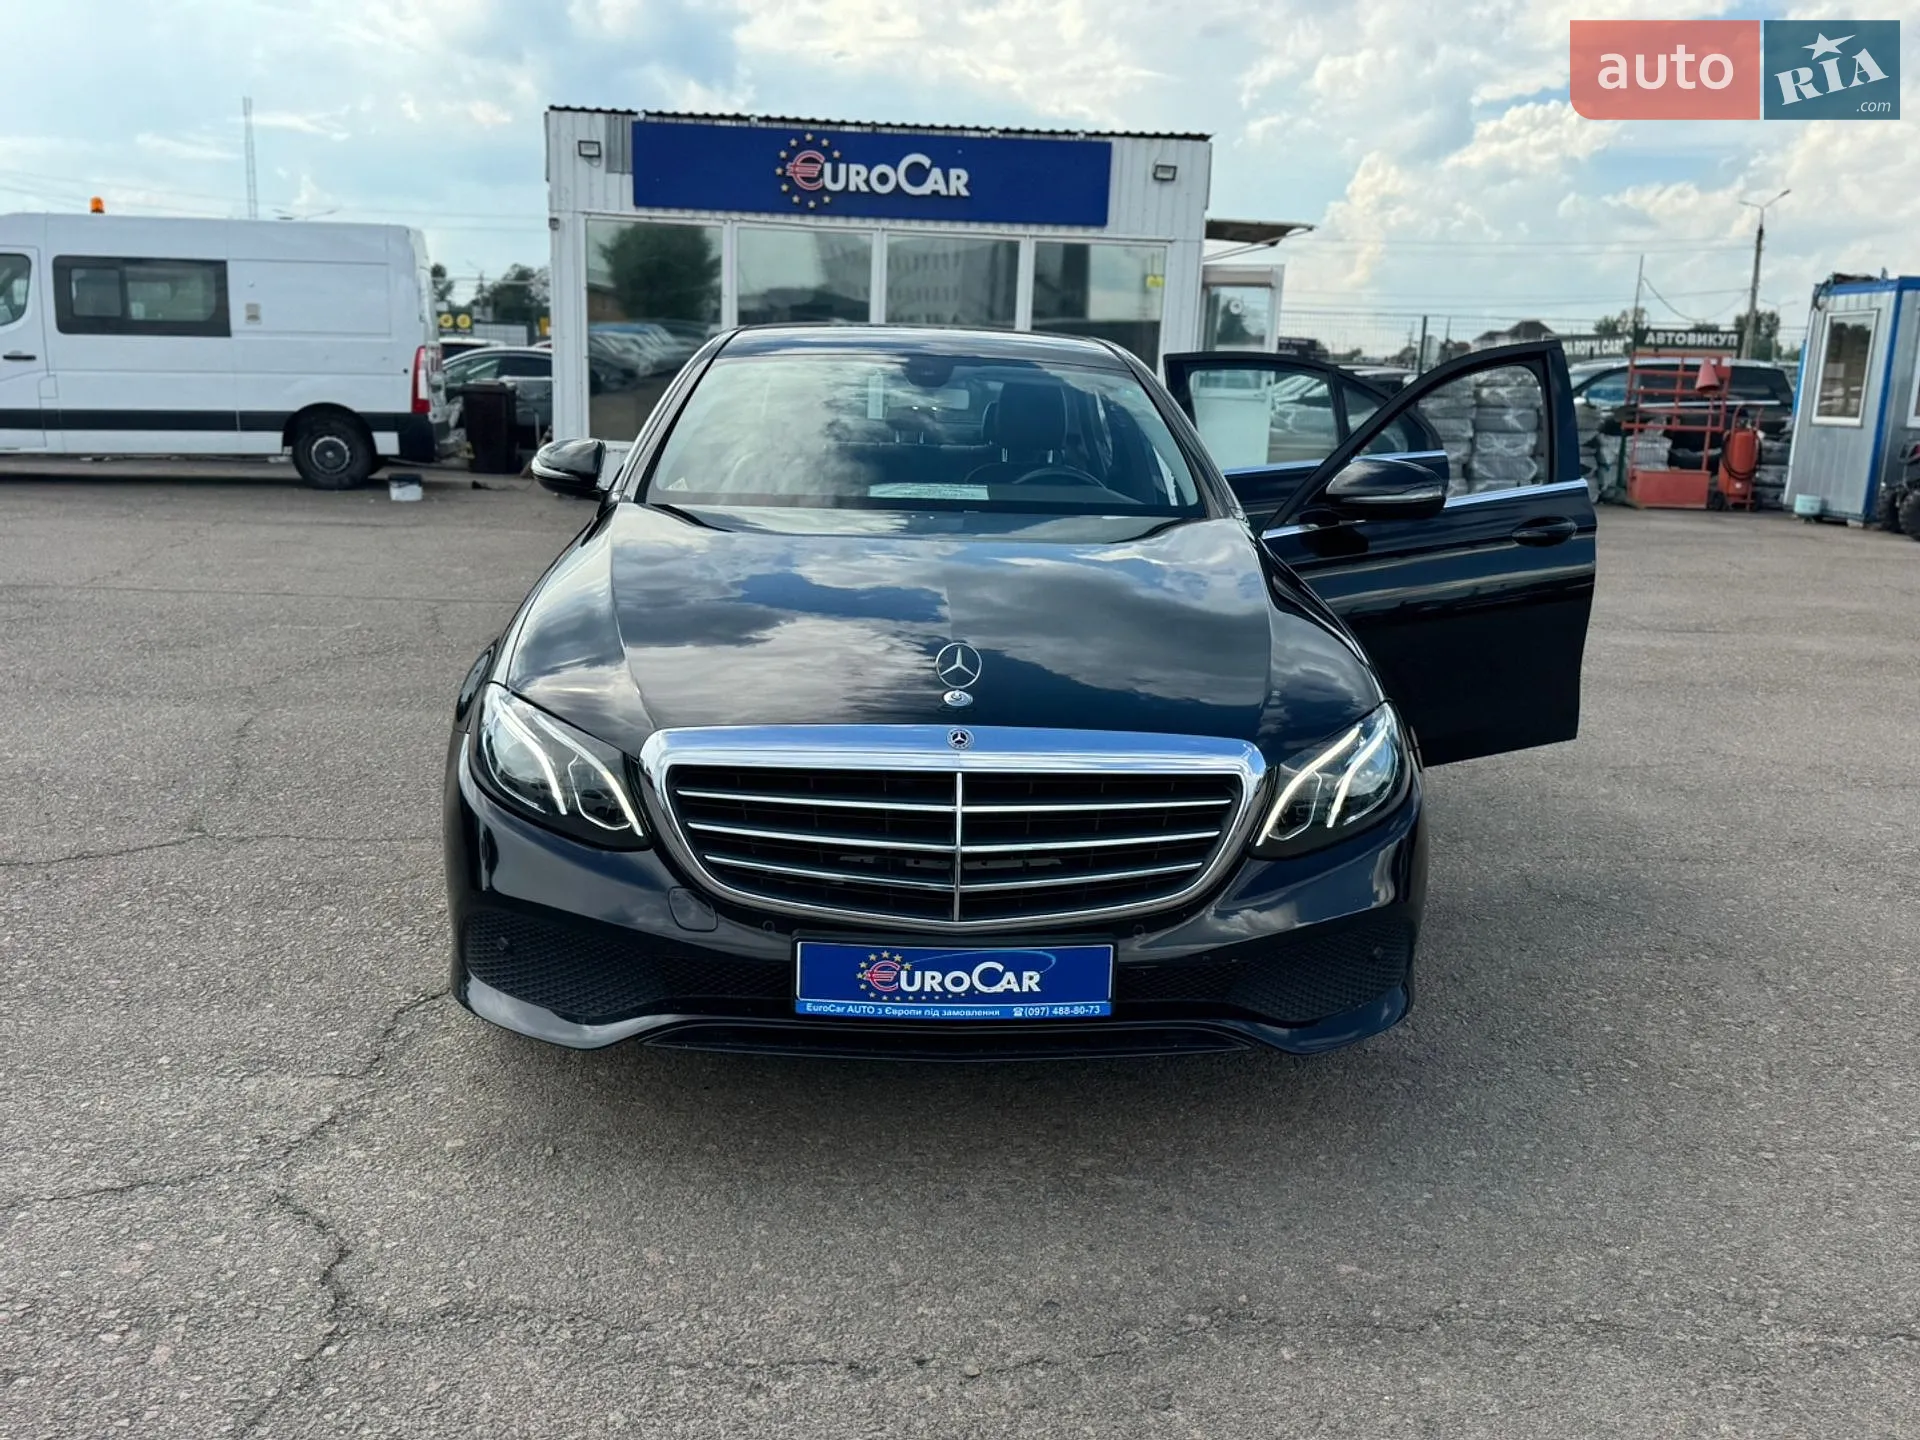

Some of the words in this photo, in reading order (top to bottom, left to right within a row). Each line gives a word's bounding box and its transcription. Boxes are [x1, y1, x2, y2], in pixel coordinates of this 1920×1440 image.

[1644, 331, 1739, 347] АВТОВИКУП
[806, 1002, 846, 1014] EuroCar
[847, 1005, 875, 1014] AUTO
[885, 1006, 922, 1017] Європи
[924, 1007, 940, 1017] під
[941, 1008, 1000, 1017] замовлення
[1024, 1006, 1050, 1017] (097)
[1051, 1005, 1101, 1016] 488-80-73
